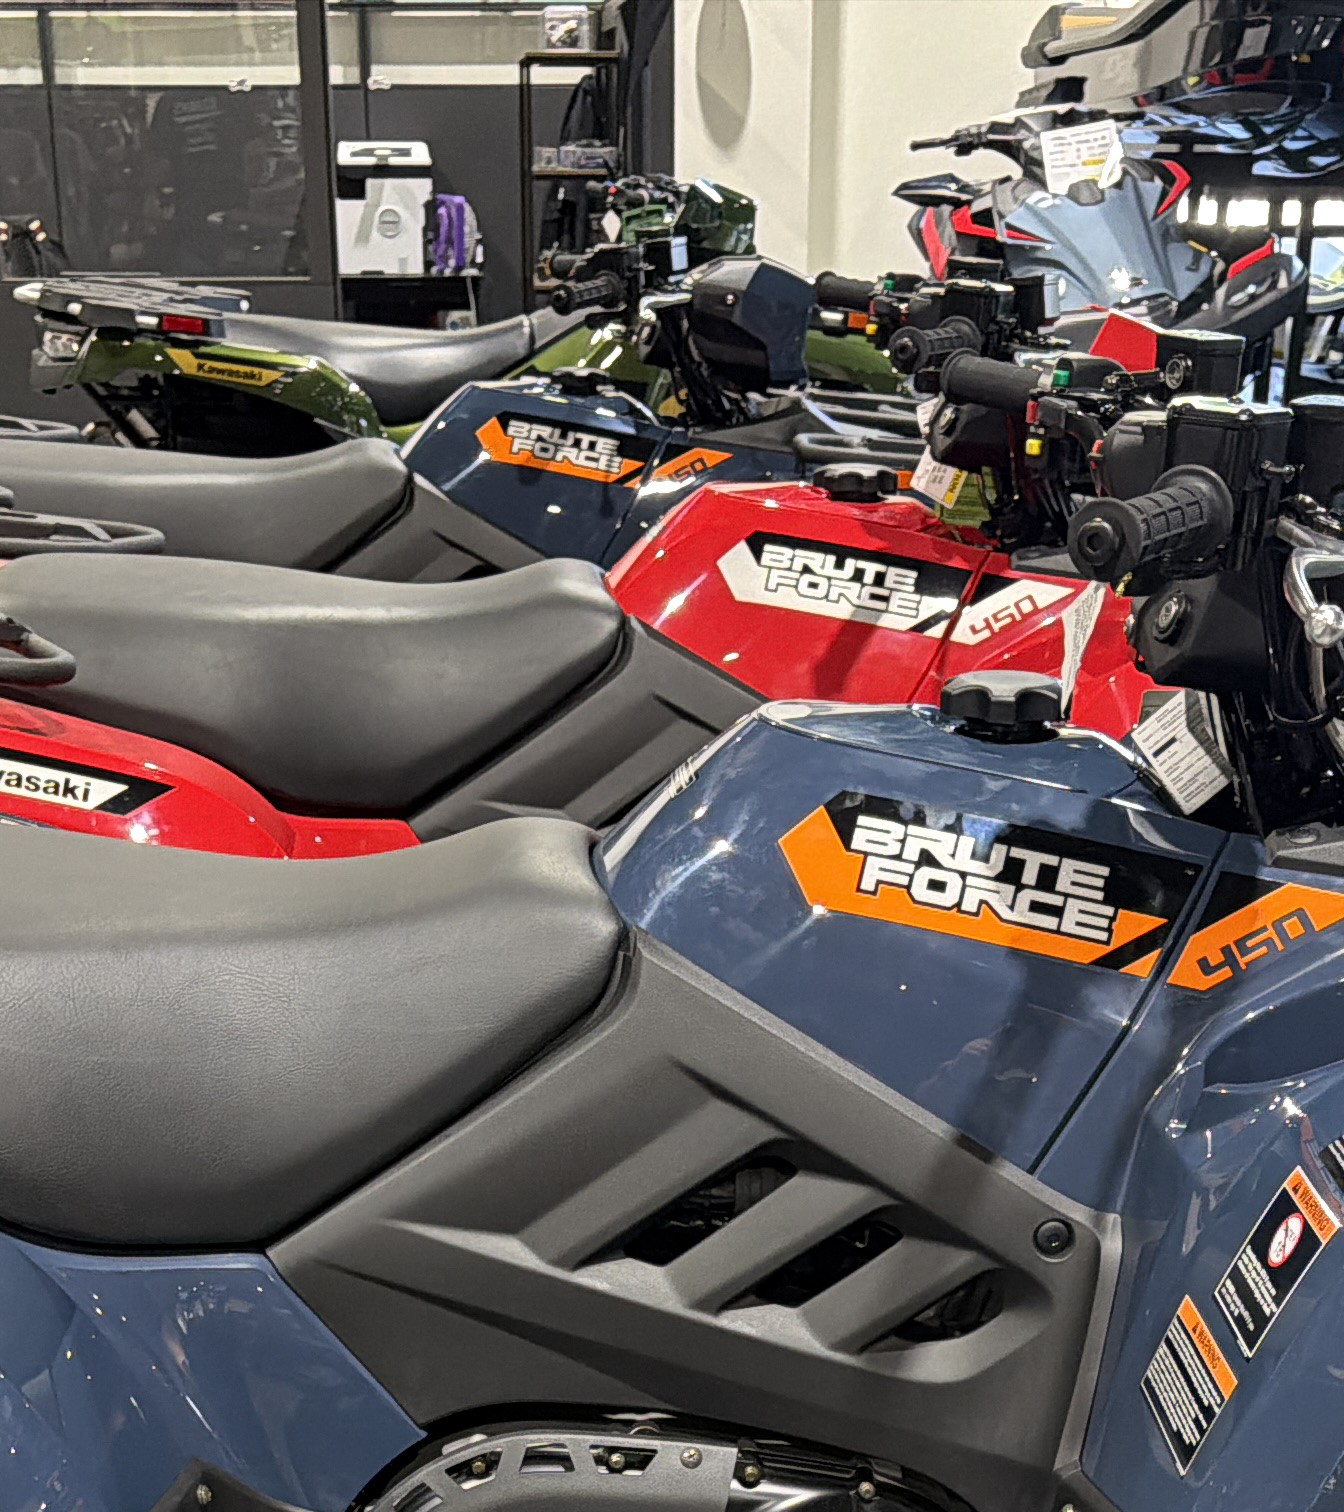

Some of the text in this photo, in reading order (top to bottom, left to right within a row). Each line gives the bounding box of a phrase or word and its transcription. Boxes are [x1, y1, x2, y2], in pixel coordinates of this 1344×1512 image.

[196, 361, 263, 381] Kawasaki
[507, 419, 621, 456] BRUTE
[510, 437, 624, 475] FORCE
[761, 543, 919, 592] BRUTE
[764, 566, 924, 618] FORCE
[969, 594, 1039, 637] 450
[851, 815, 1111, 901] BRUTE
[858, 854, 1115, 942] FORCE
[1197, 906, 1317, 979] 450
[1299, 1186, 1330, 1232] WARNING
